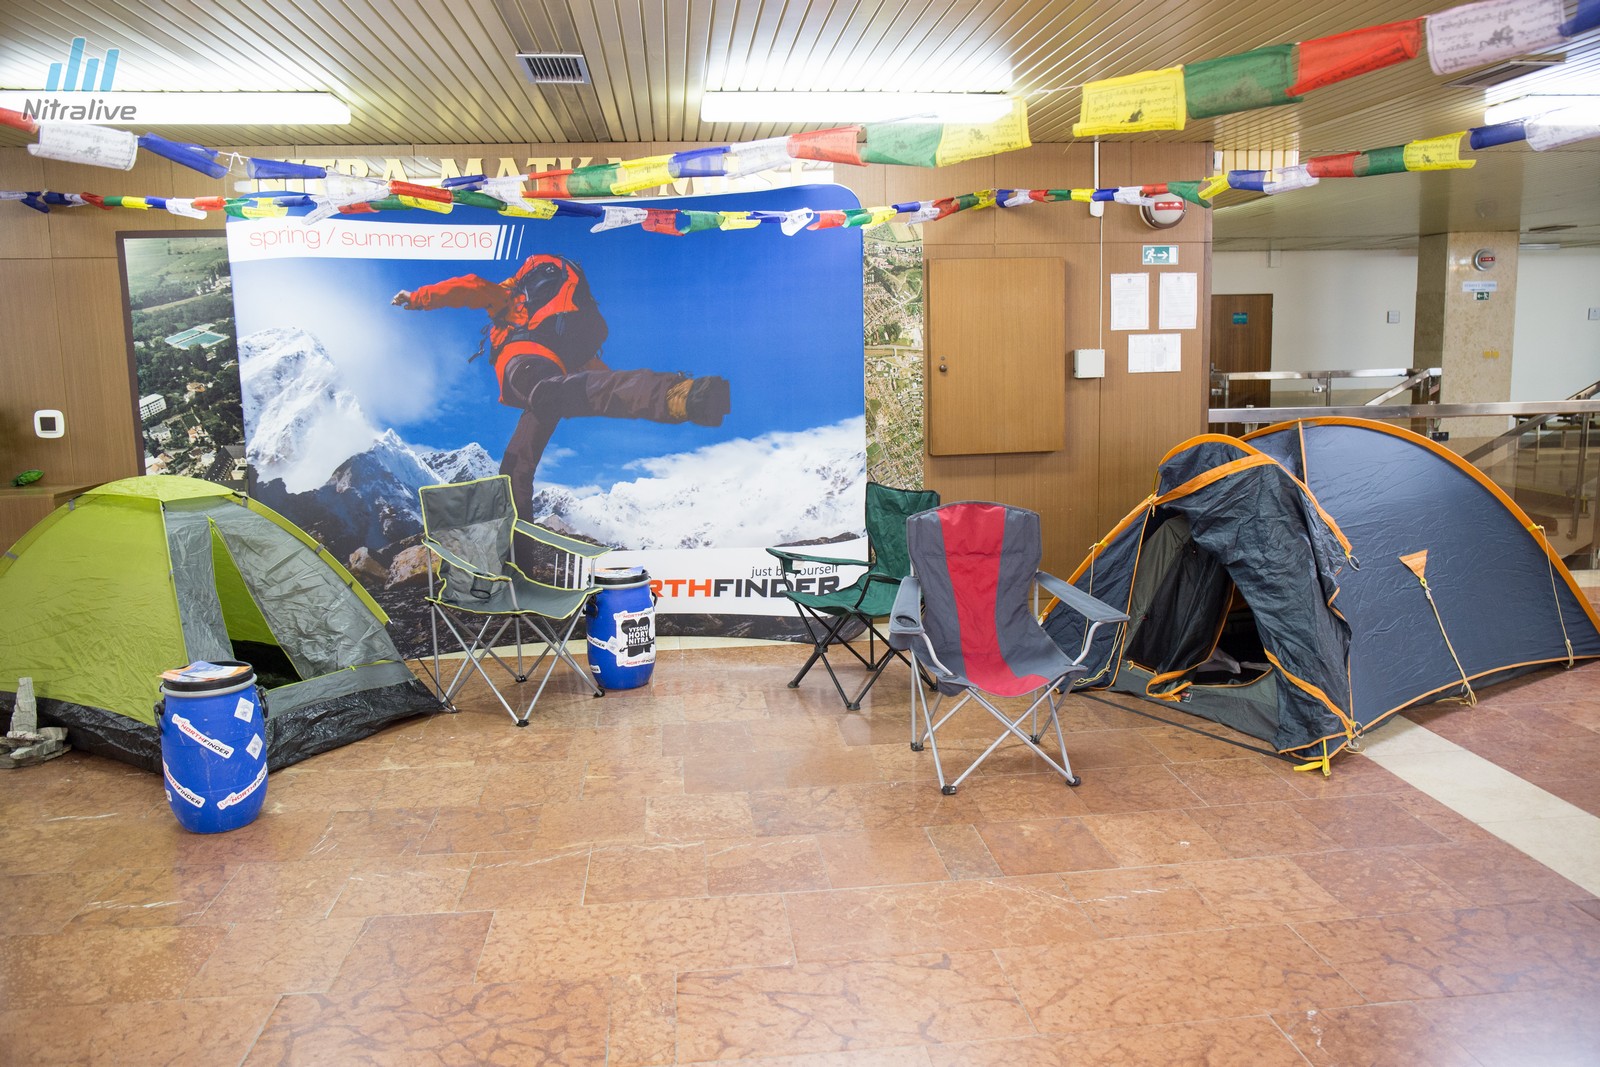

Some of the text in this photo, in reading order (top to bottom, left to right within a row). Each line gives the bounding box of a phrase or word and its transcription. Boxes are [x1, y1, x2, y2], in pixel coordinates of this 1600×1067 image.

[249, 225, 493, 250] spring / summer 2016
[751, 566, 772, 579] just
[649, 575, 840, 598] RTHFINDER
[628, 630, 649, 639] HORY
[628, 636, 649, 645] NITRA
[180, 723, 230, 756] NORTHFINDER
